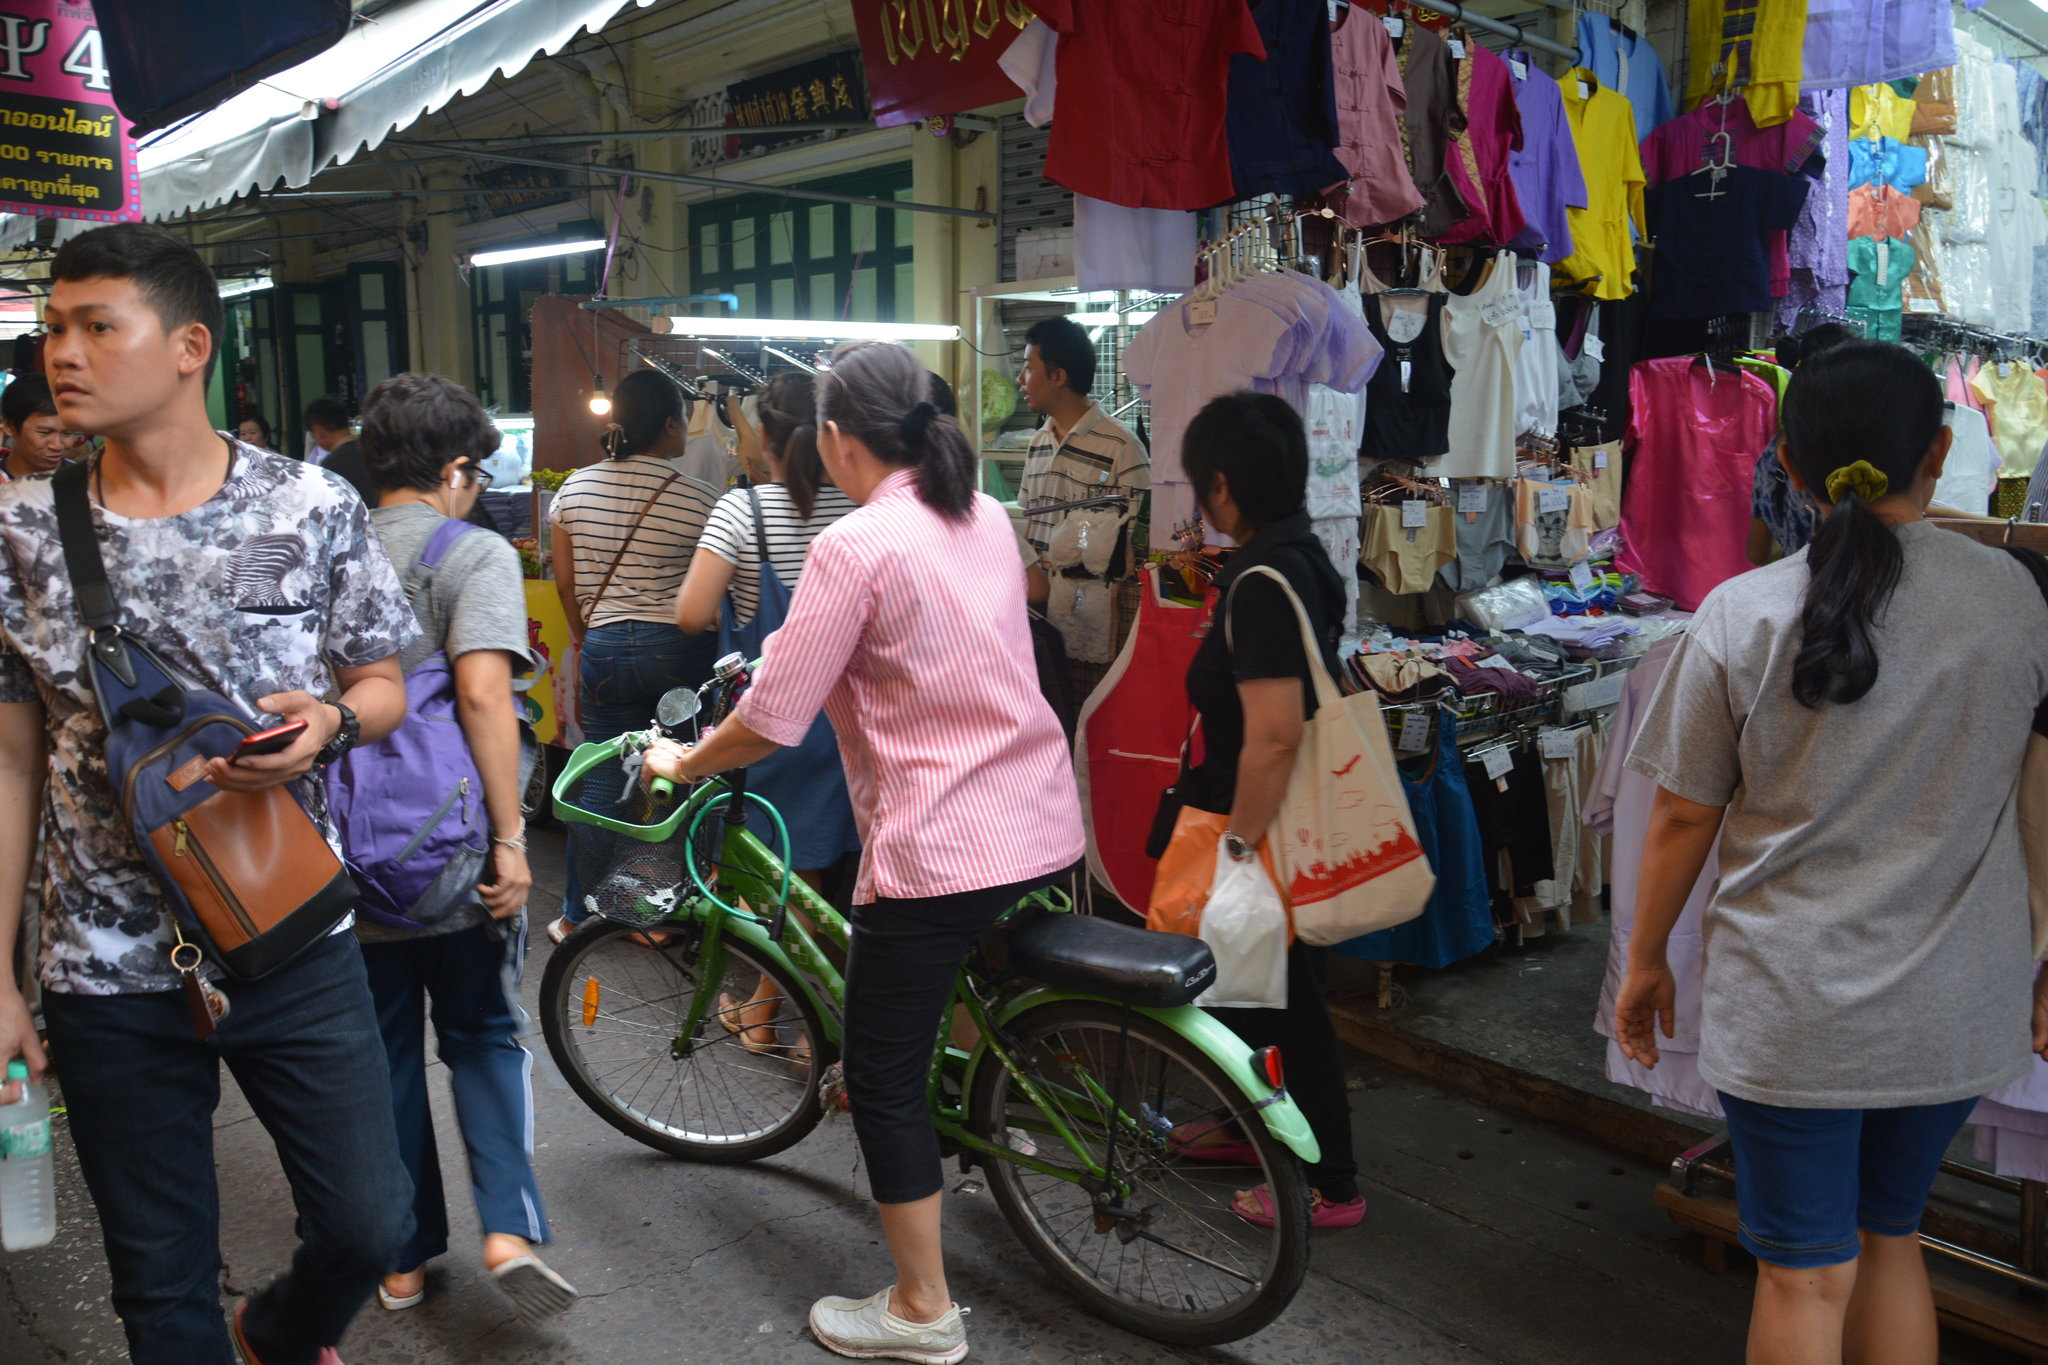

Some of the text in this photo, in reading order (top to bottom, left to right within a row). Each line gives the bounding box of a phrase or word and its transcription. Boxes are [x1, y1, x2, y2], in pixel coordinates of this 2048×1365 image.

[62, 27, 111, 91] 4
[36, 150, 114, 171] รายการ
[0, 173, 100, 204] คาถูกที่สุด
